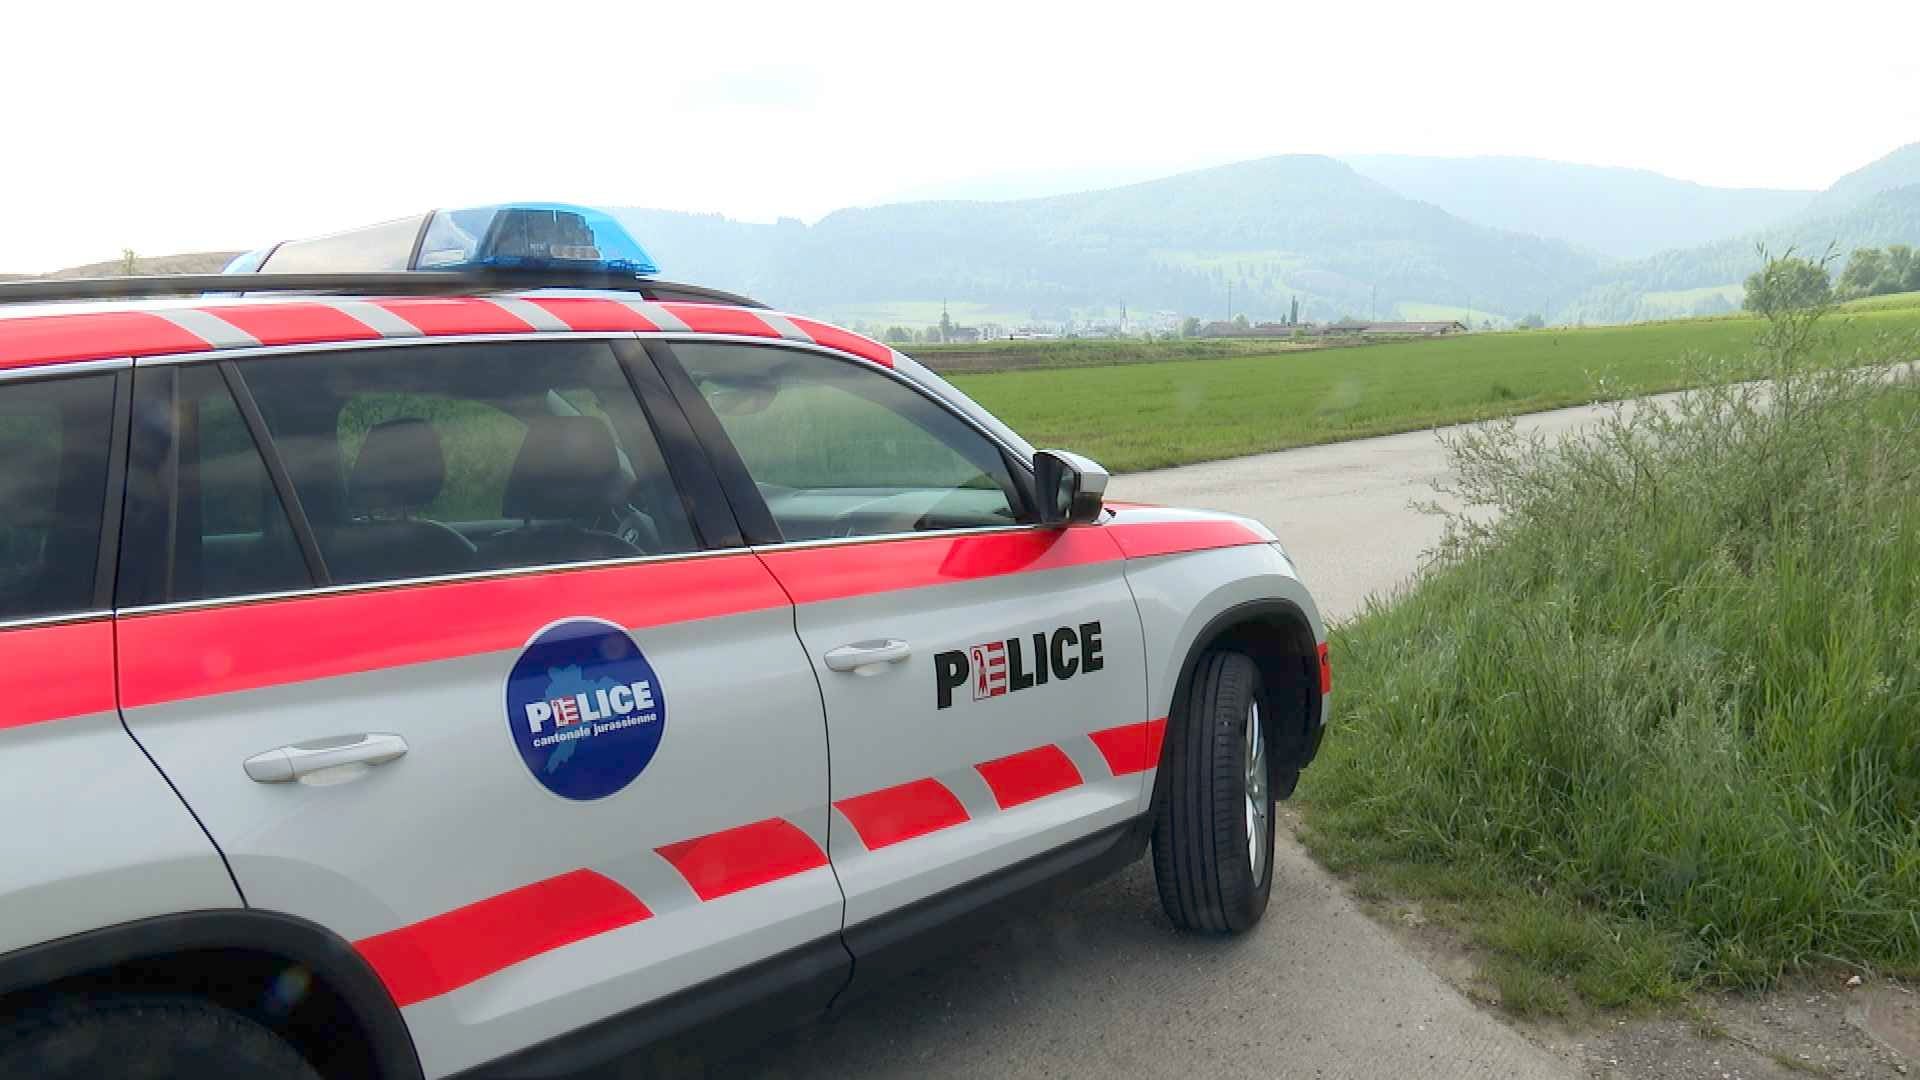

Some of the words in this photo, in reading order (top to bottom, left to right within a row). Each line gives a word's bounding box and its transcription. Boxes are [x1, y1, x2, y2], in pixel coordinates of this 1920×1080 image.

[934, 621, 1104, 710] PLICE
[525, 680, 655, 733] PLICE
[533, 726, 591, 748] cantonale
[593, 712, 657, 736] jurassienne
